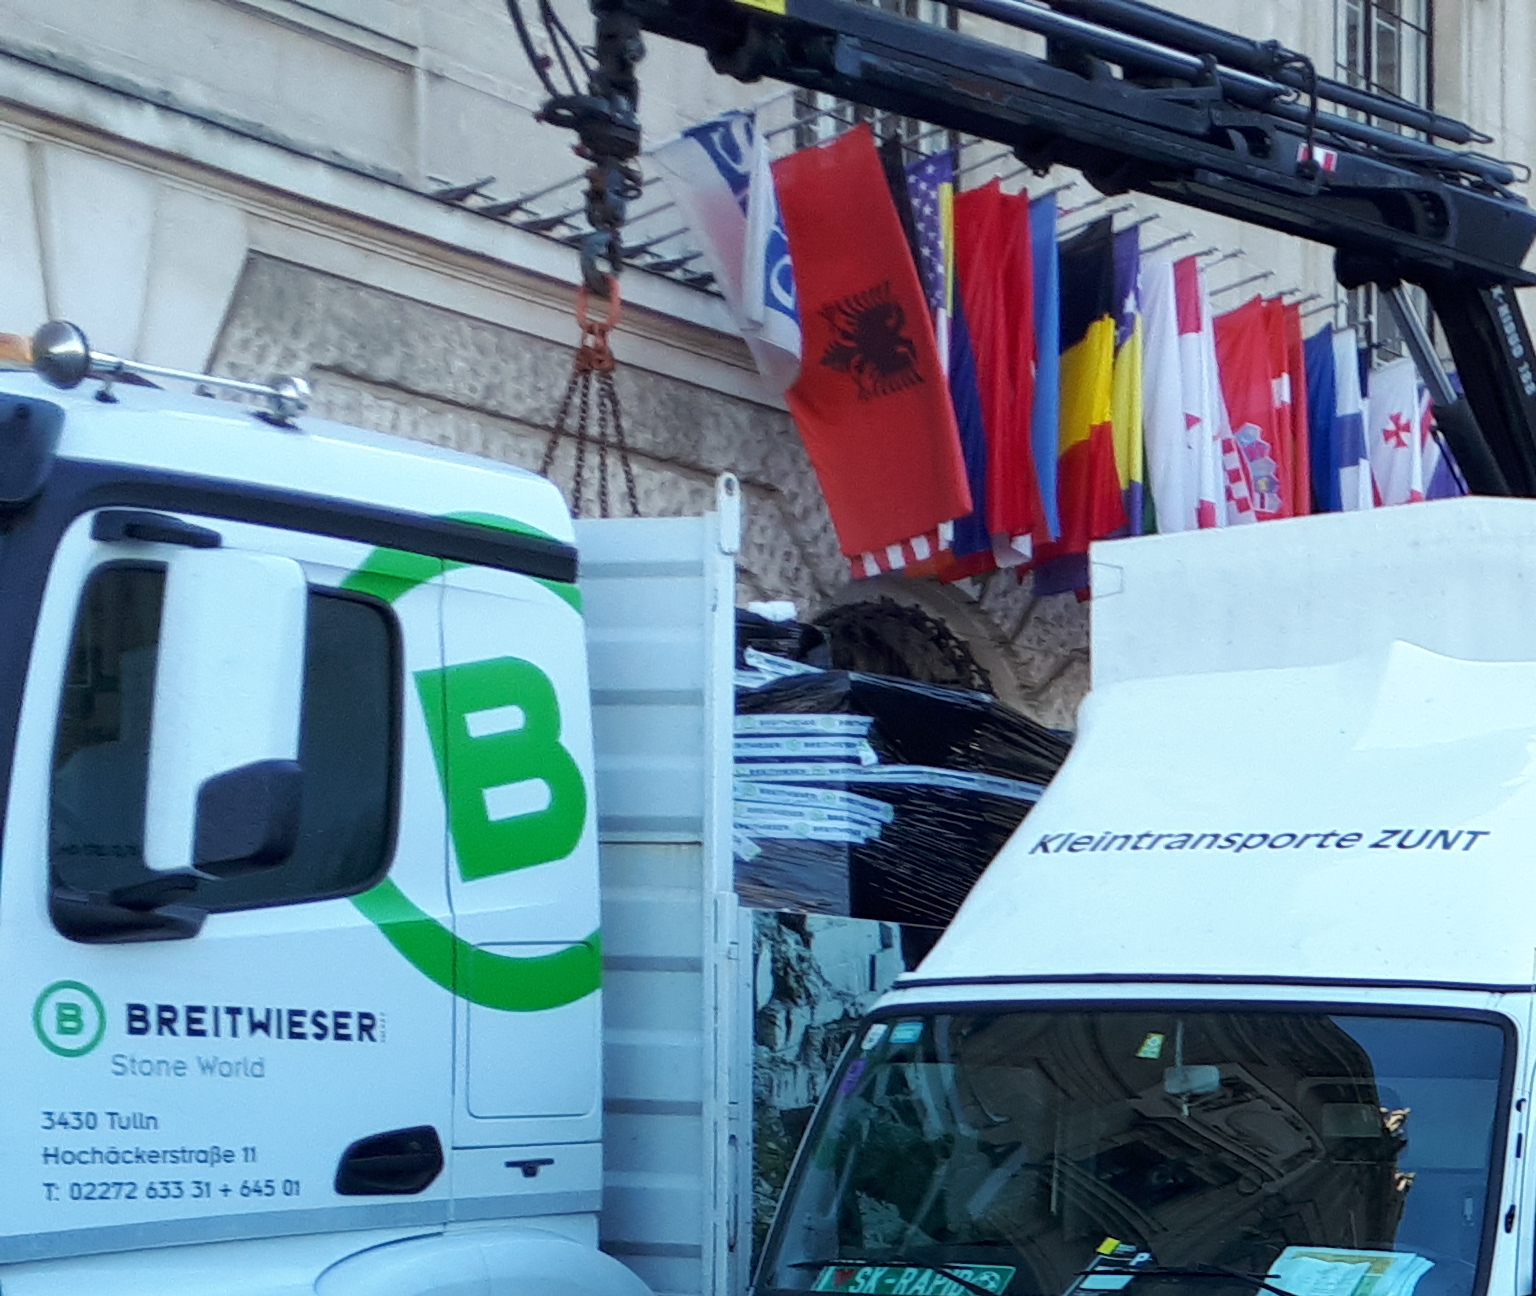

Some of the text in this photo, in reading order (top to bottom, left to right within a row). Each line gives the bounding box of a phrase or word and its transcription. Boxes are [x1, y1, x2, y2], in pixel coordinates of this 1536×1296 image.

[412, 655, 587, 883] B
[1029, 829, 1491, 855] Kleintransporte ZUNT
[125, 1002, 377, 1043] BREITWIESER
[111, 1054, 265, 1078] Stone World
[41, 1111, 158, 1131] 3430 Tulln
[42, 1146, 257, 1167] Hochäckerstraße 11
[69, 1182, 137, 1201] 02272
[145, 1180, 184, 1199] 633
[191, 1180, 211, 1198] 31
[219, 1184, 232, 1196] +
[239, 1179, 276, 1197] 645
[282, 1178, 299, 1197] 01
